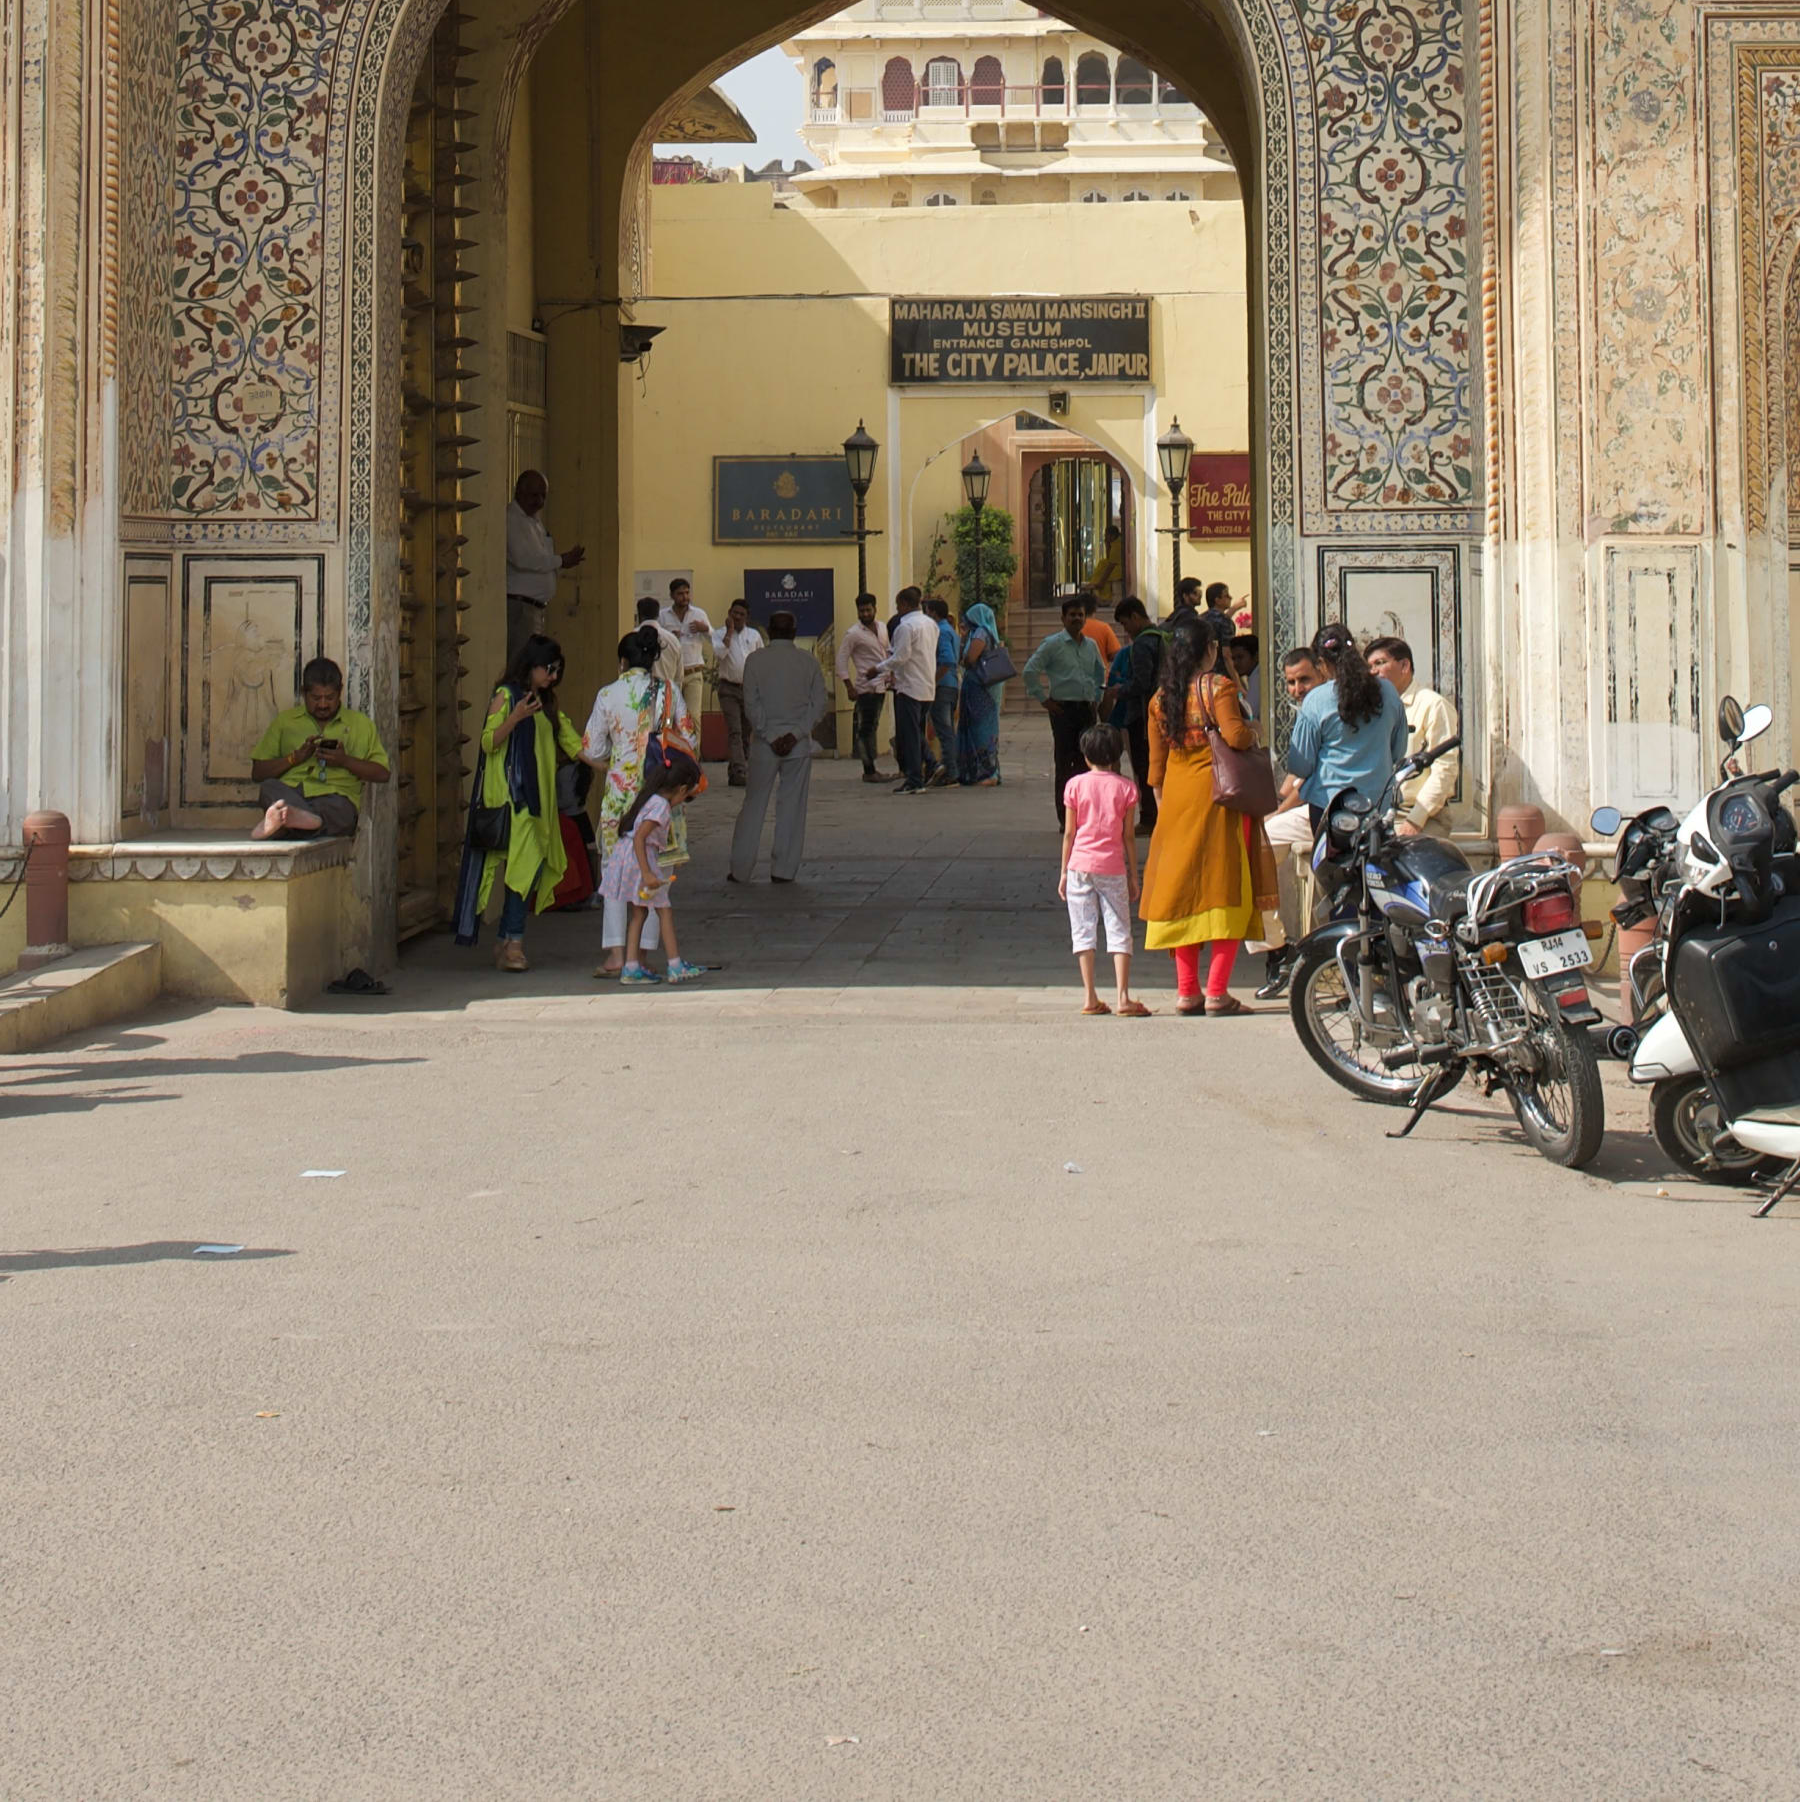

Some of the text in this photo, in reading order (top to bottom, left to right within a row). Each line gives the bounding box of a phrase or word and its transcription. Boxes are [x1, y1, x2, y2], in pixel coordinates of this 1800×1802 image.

[894, 302, 1146, 320] MAHARAJA SAWAI MANSINGH II
[963, 321, 1062, 337] MUSEUM
[933, 337, 1092, 349] ENTRANCE GANESHPOL
[902, 352, 940, 377] THE
[946, 352, 998, 377] CITY
[1190, 482, 1220, 508] The
[731, 508, 842, 521] BARADARI
[1207, 510, 1223, 521] THE
[1224, 510, 1245, 521] CITY
[1532, 950, 1589, 975] VS 2533
